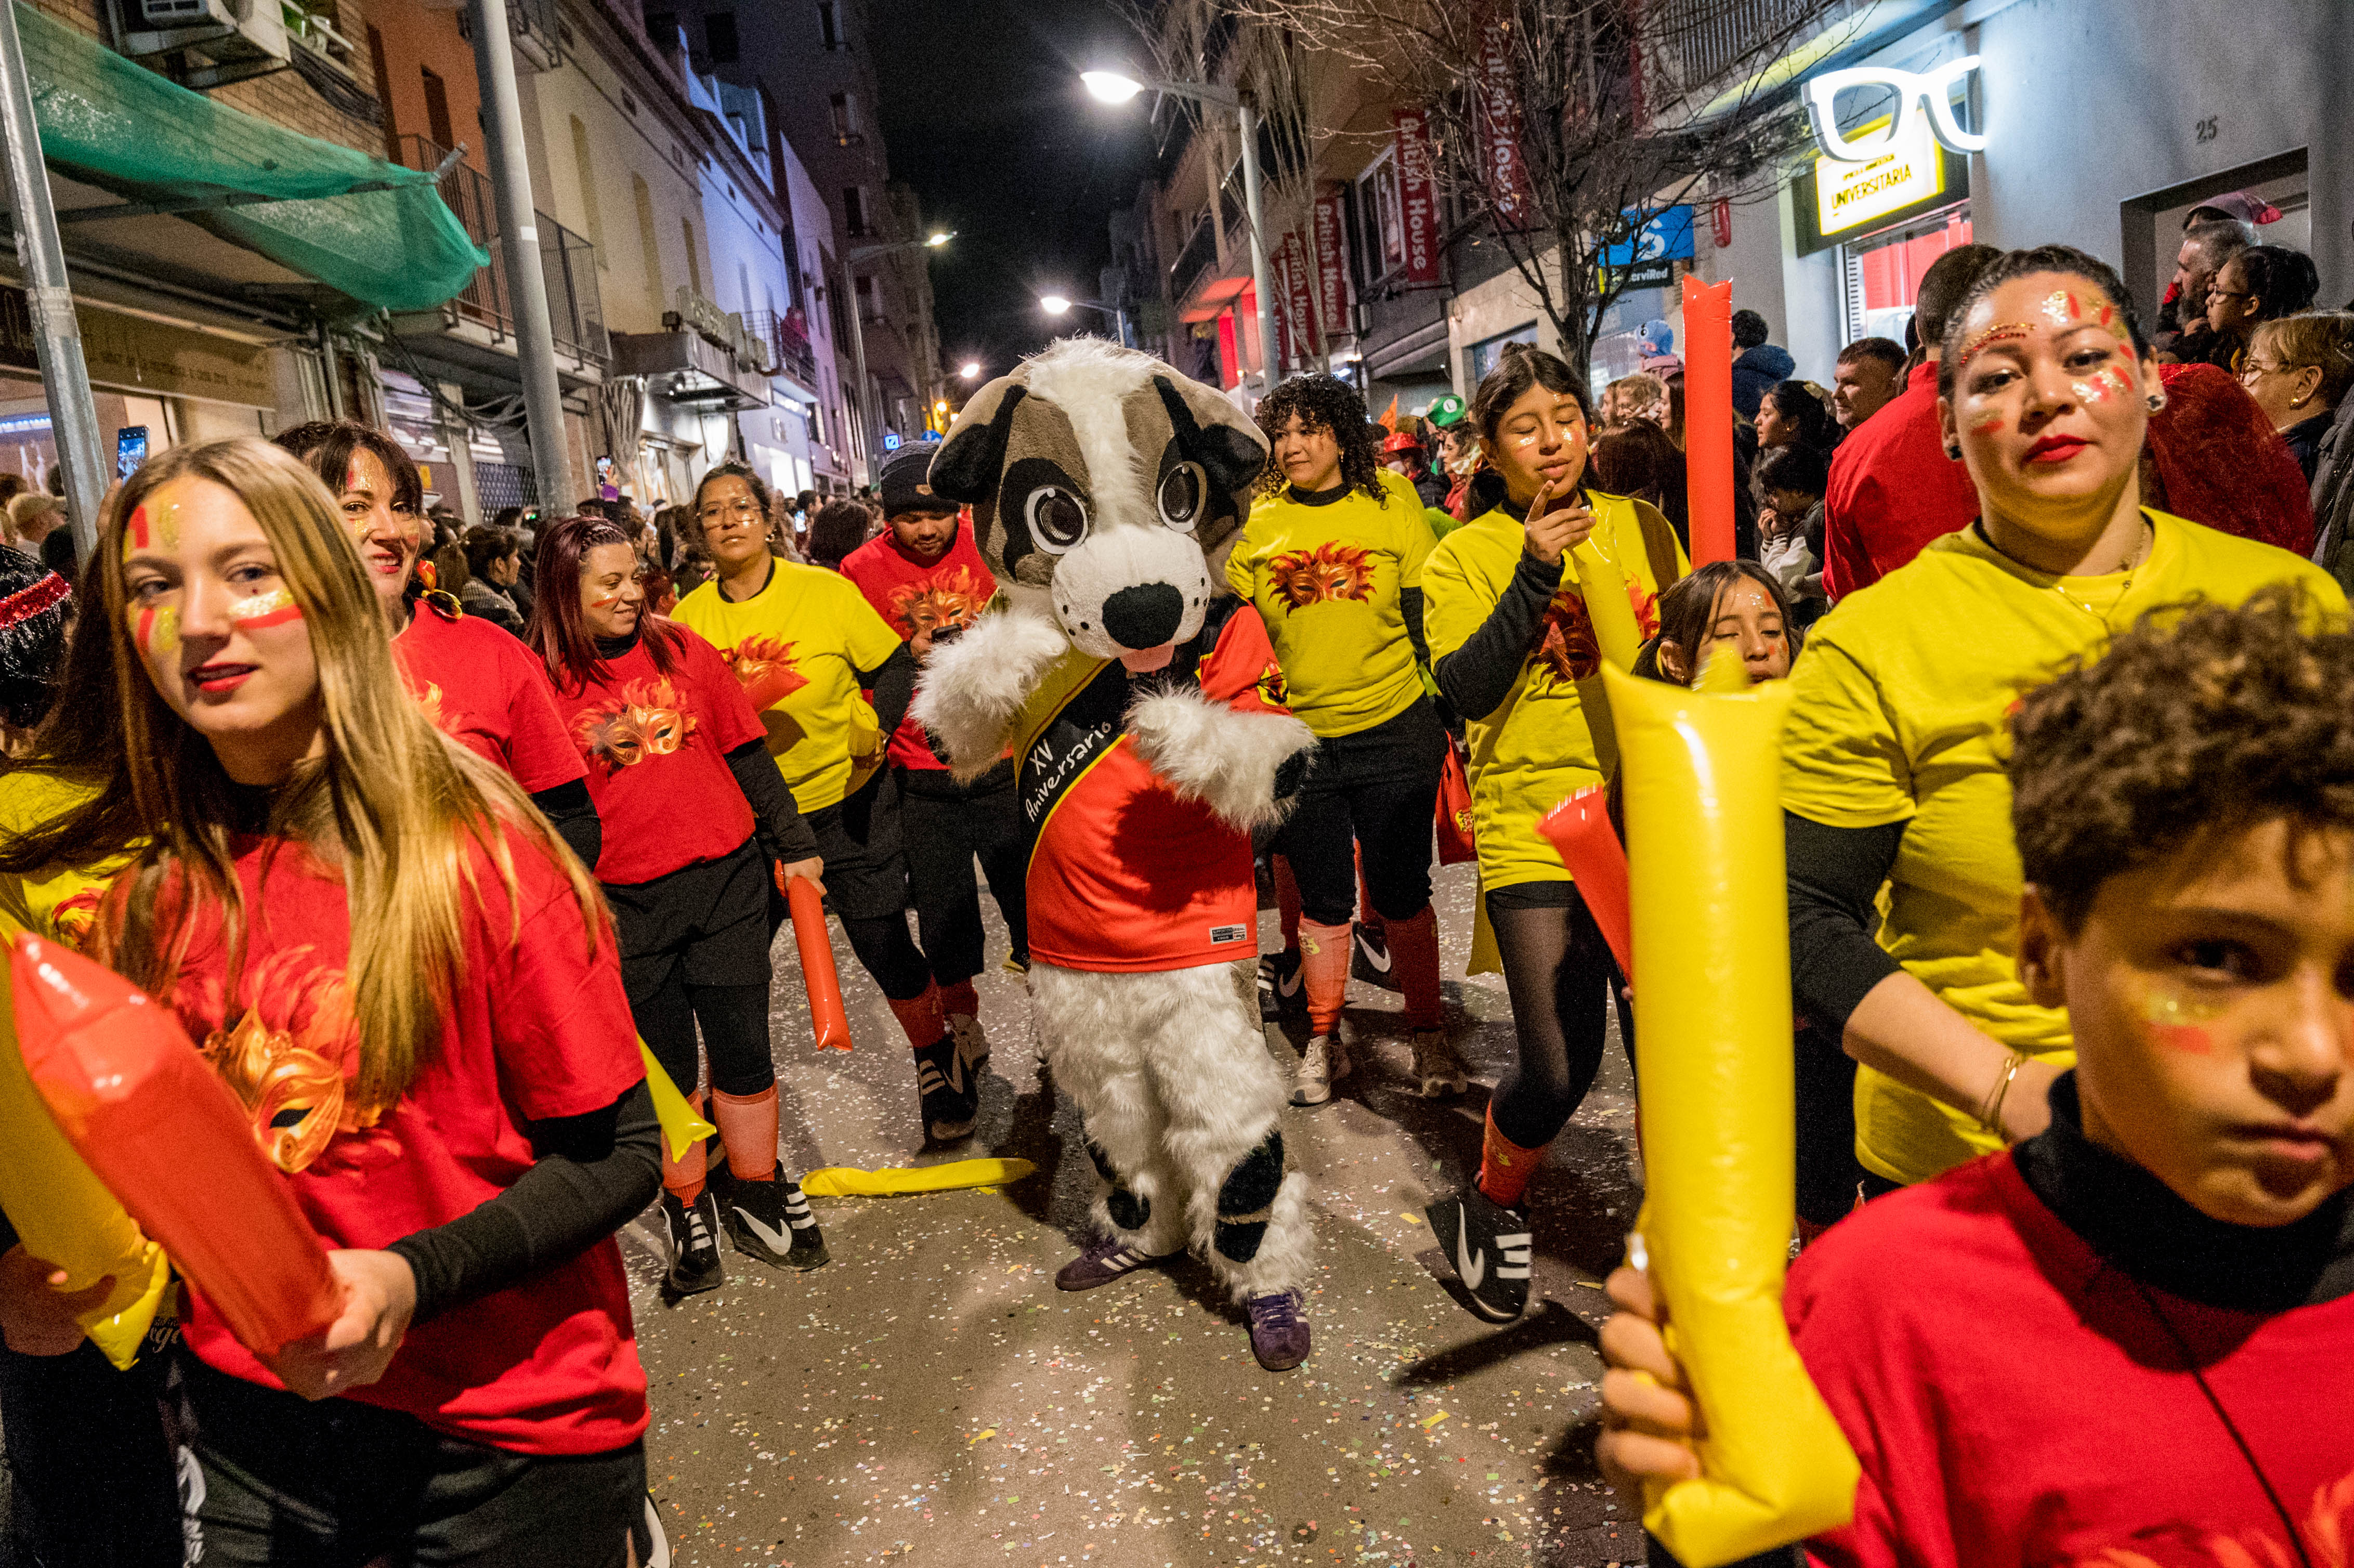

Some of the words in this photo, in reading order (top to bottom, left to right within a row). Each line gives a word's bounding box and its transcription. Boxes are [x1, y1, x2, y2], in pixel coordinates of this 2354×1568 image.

[2196, 115, 2218, 144] 25
[1832, 164, 1912, 209] UNIVERSITARIA
[1317, 204, 1336, 262] British
[1408, 198, 1428, 270] House
[1322, 267, 1338, 324] House
[1628, 267, 1668, 282] erviRed
[1025, 721, 1111, 822] Aniversario
[1029, 738, 1054, 775] XV
